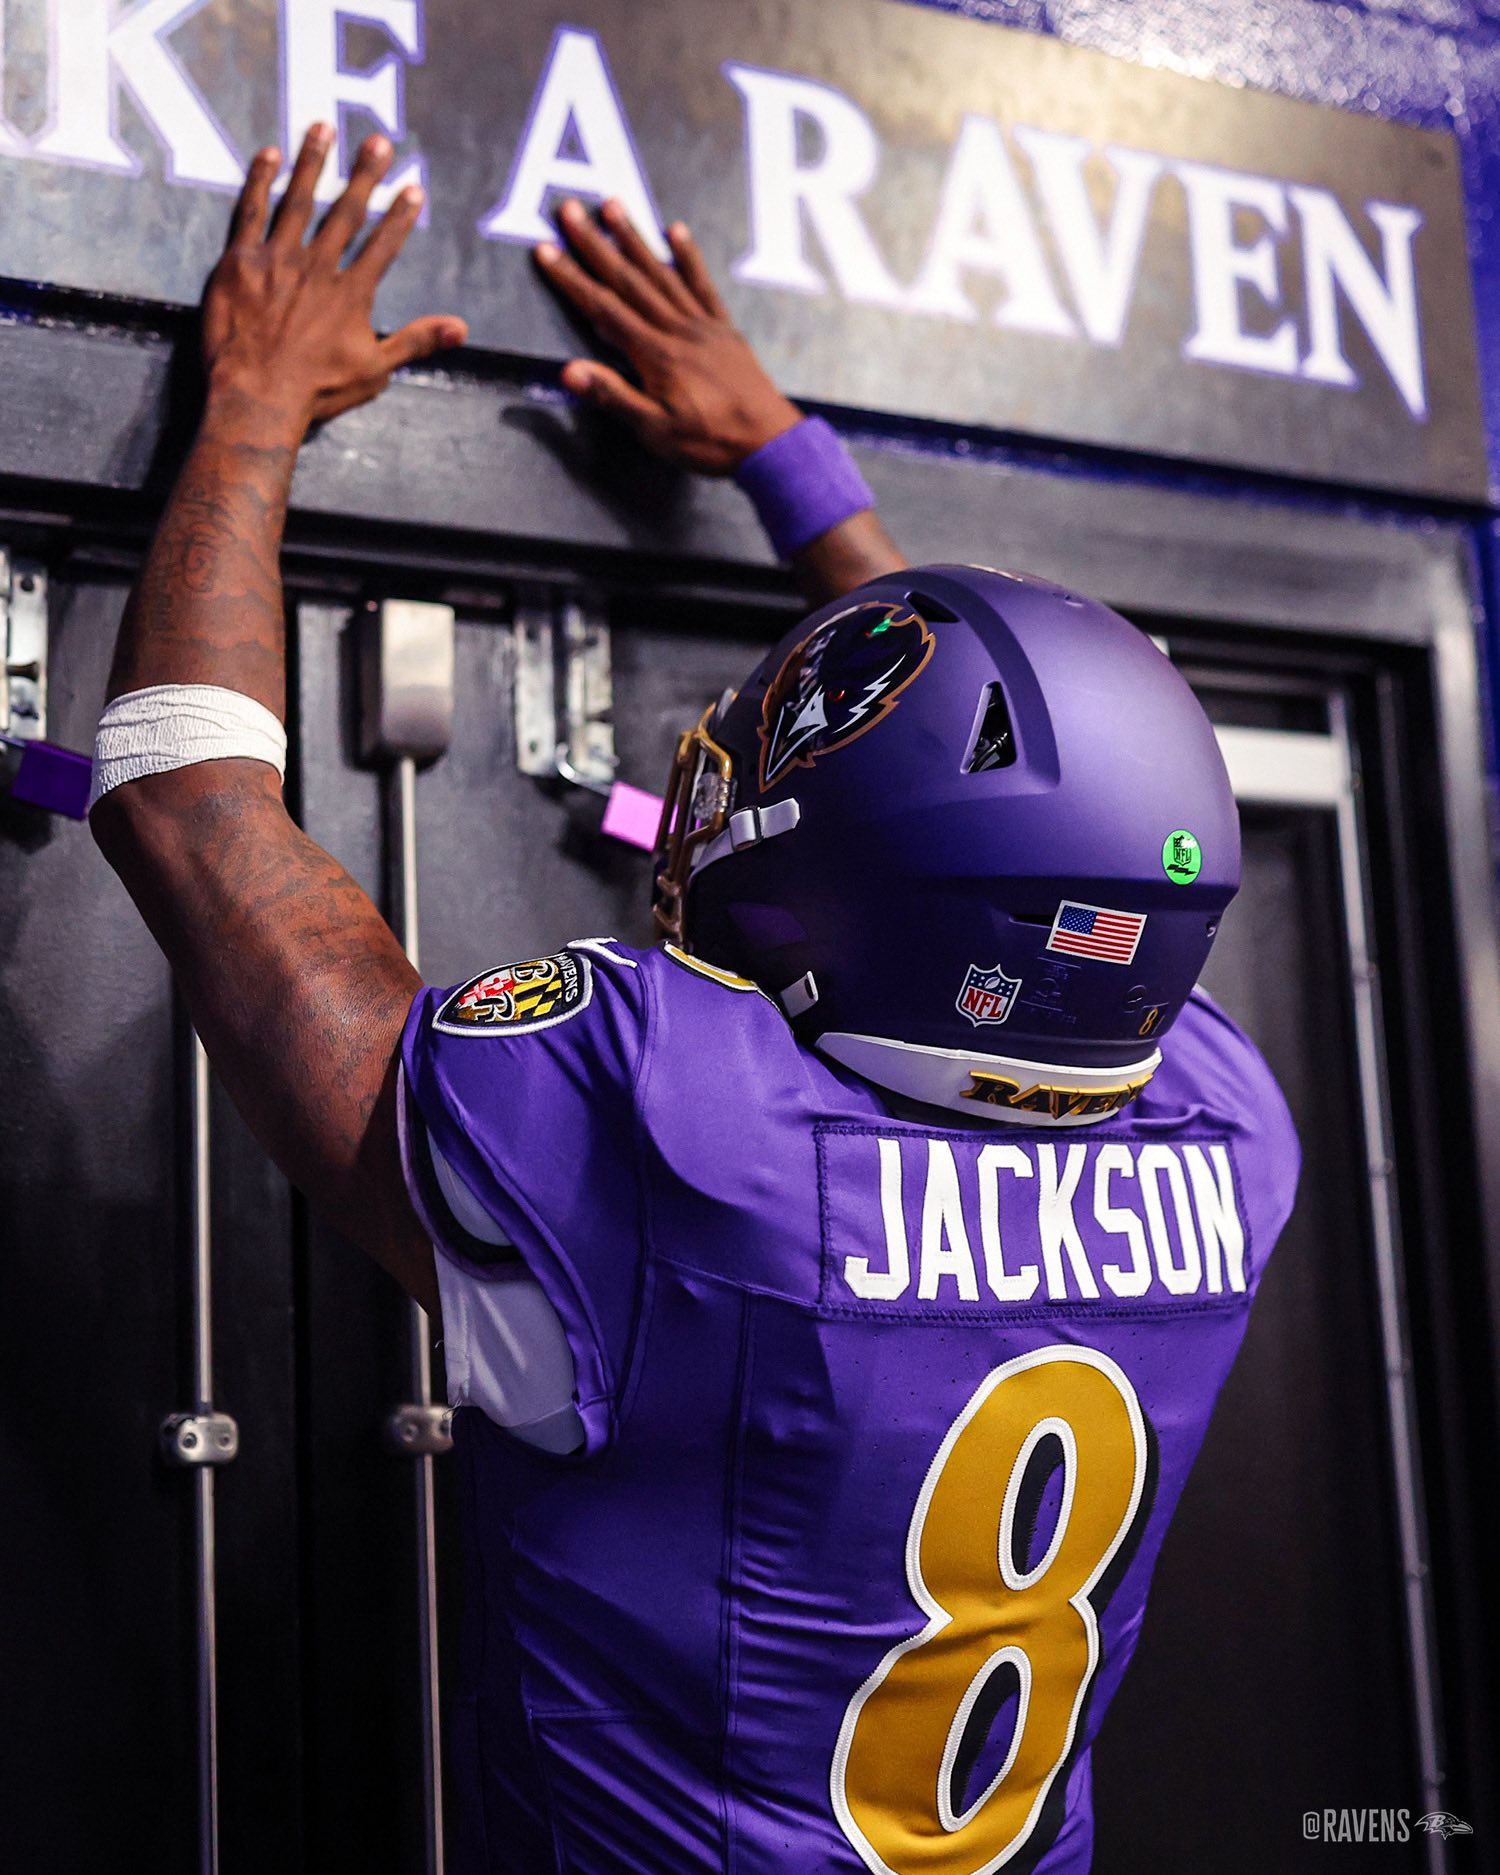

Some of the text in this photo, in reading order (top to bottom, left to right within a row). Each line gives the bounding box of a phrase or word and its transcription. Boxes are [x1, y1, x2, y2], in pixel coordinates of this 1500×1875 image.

[478, 22, 677, 264] A
[722, 59, 1425, 421] RAVEN
[961, 986, 1010, 1019] NFL
[1138, 1007, 1159, 1036] 8
[844, 1138, 1247, 1301] JACKSON
[829, 1343, 1154, 1875] 8
